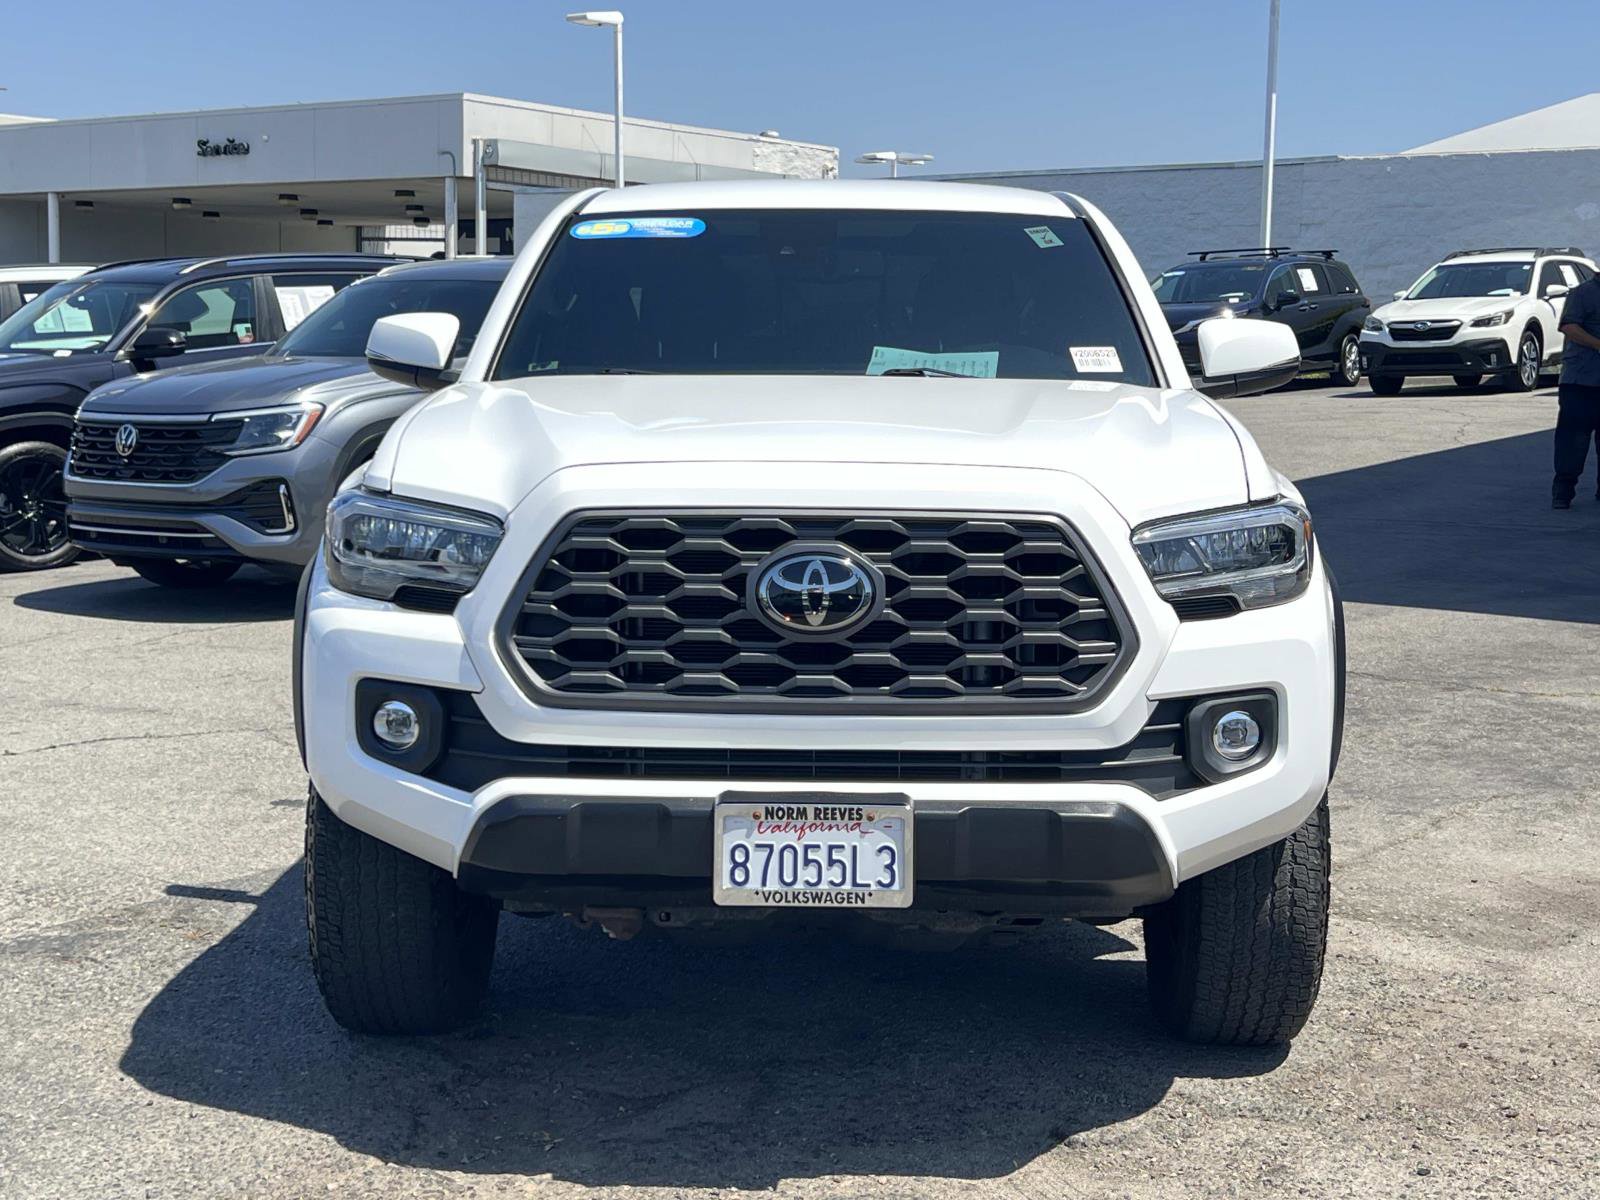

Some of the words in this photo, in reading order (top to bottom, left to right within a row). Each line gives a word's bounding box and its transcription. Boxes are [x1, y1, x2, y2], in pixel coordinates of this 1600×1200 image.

[764, 806, 809, 821] NORM
[813, 807, 864, 821] REEVES
[757, 820, 875, 841] California
[729, 843, 897, 889] 87055L3
[761, 890, 866, 905] VOLKSWAGEN
